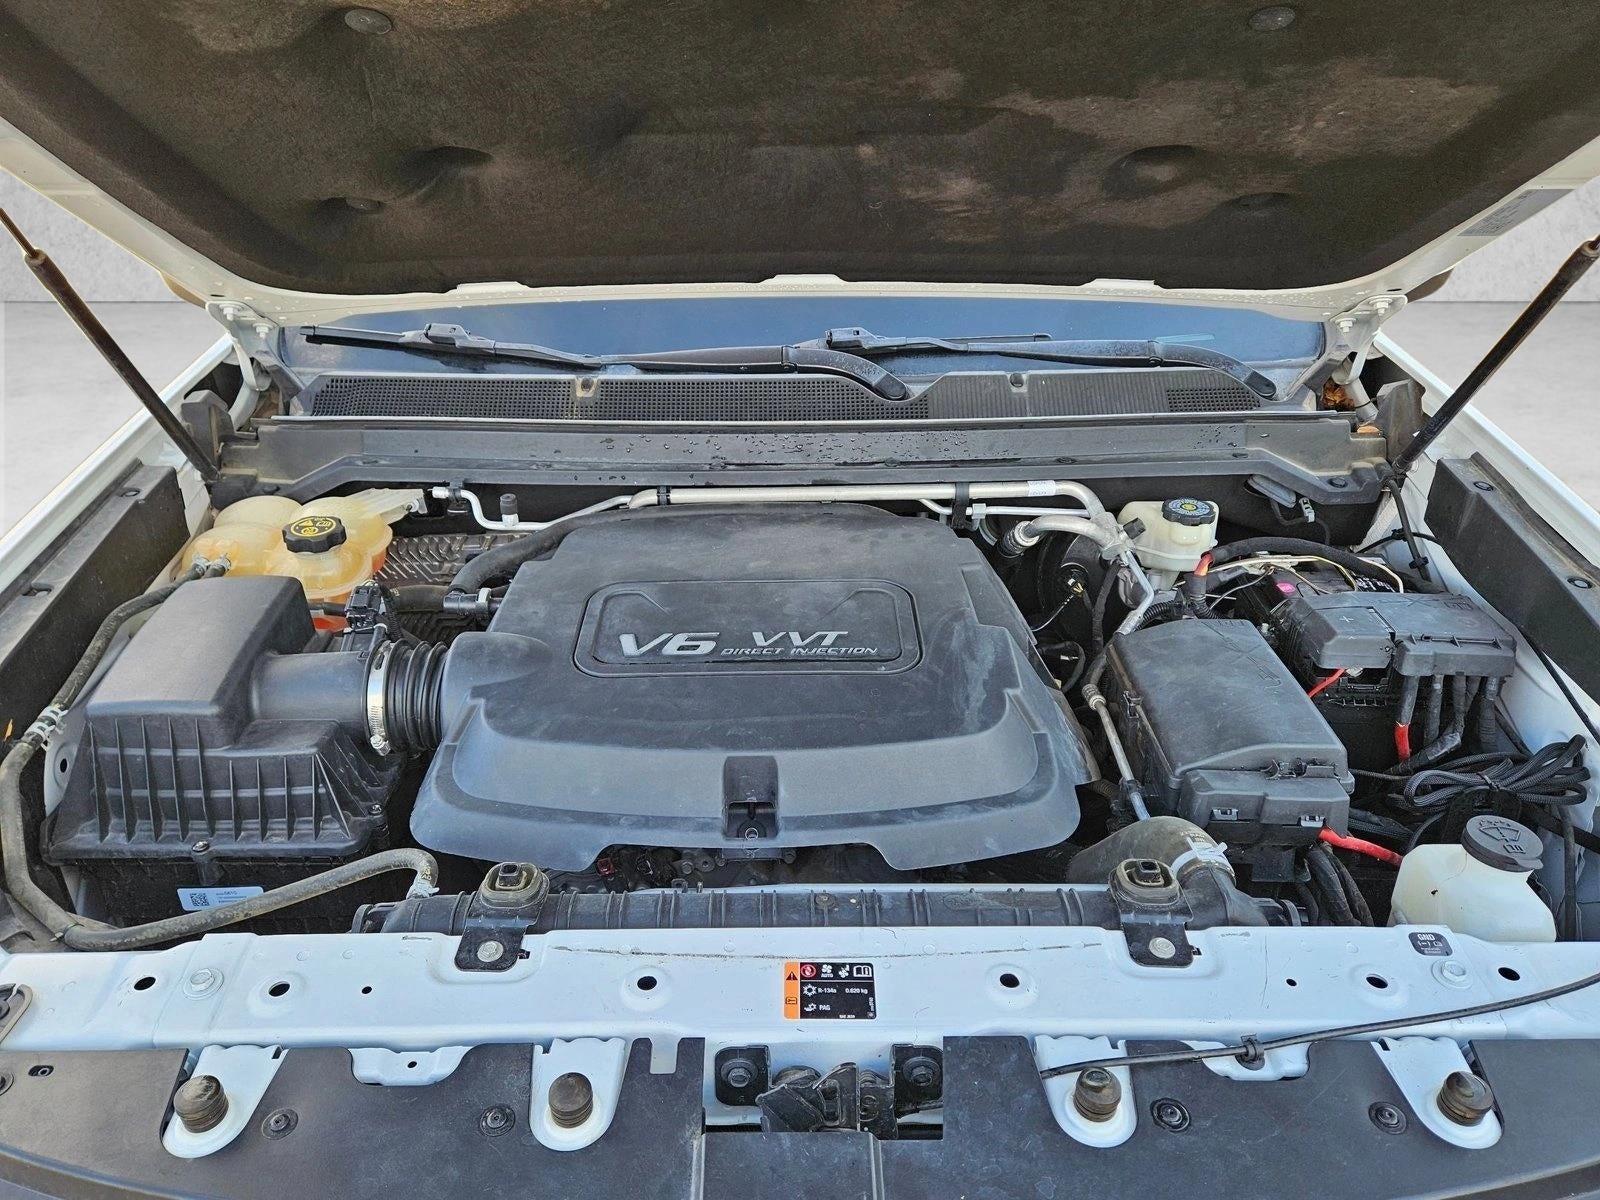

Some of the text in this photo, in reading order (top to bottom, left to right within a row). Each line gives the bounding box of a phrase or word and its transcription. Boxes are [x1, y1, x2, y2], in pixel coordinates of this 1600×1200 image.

[618, 632, 721, 658] V6
[751, 631, 849, 647] VVT
[720, 647, 879, 657] DIRECT INJECTION
[1417, 933, 1436, 941] GND
